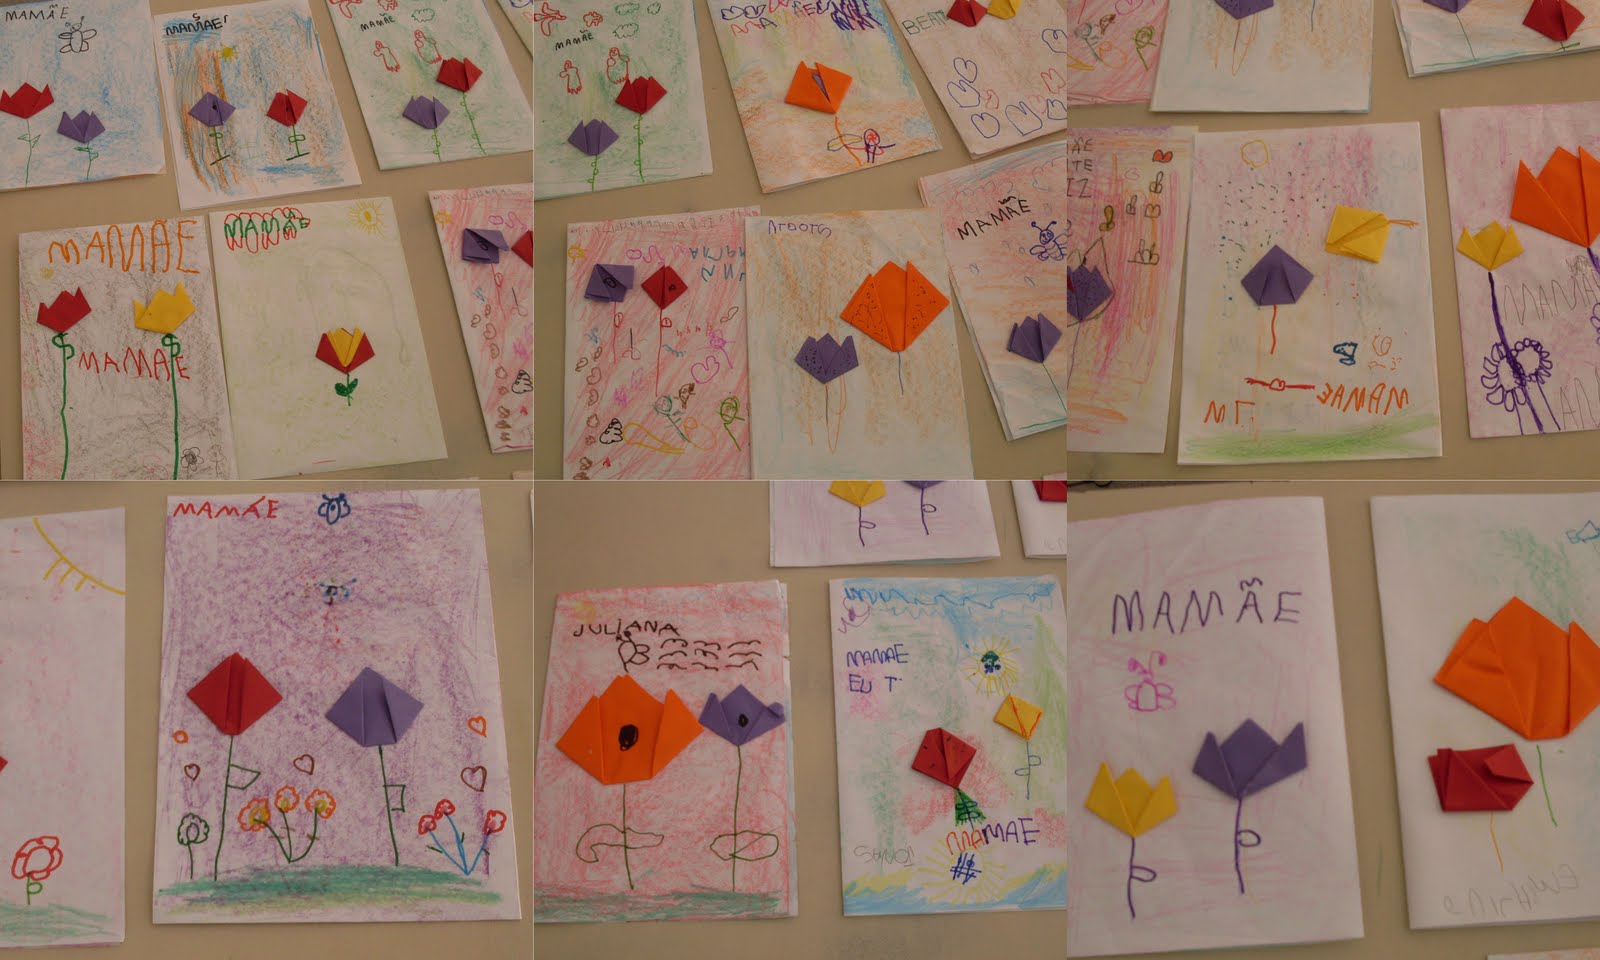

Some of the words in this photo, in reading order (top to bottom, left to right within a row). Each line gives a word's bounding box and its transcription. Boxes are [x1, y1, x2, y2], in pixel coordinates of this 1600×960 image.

[5, 4, 69, 22] MAMÃE
[360, 13, 395, 31] MAMÃE
[555, 30, 594, 51] MAMÃE
[78, 346, 190, 382] MAMAE
[1112, 577, 1302, 635] MAMÃE
[846, 643, 909, 667] MAMAE
[946, 817, 1040, 856] MAMAE
